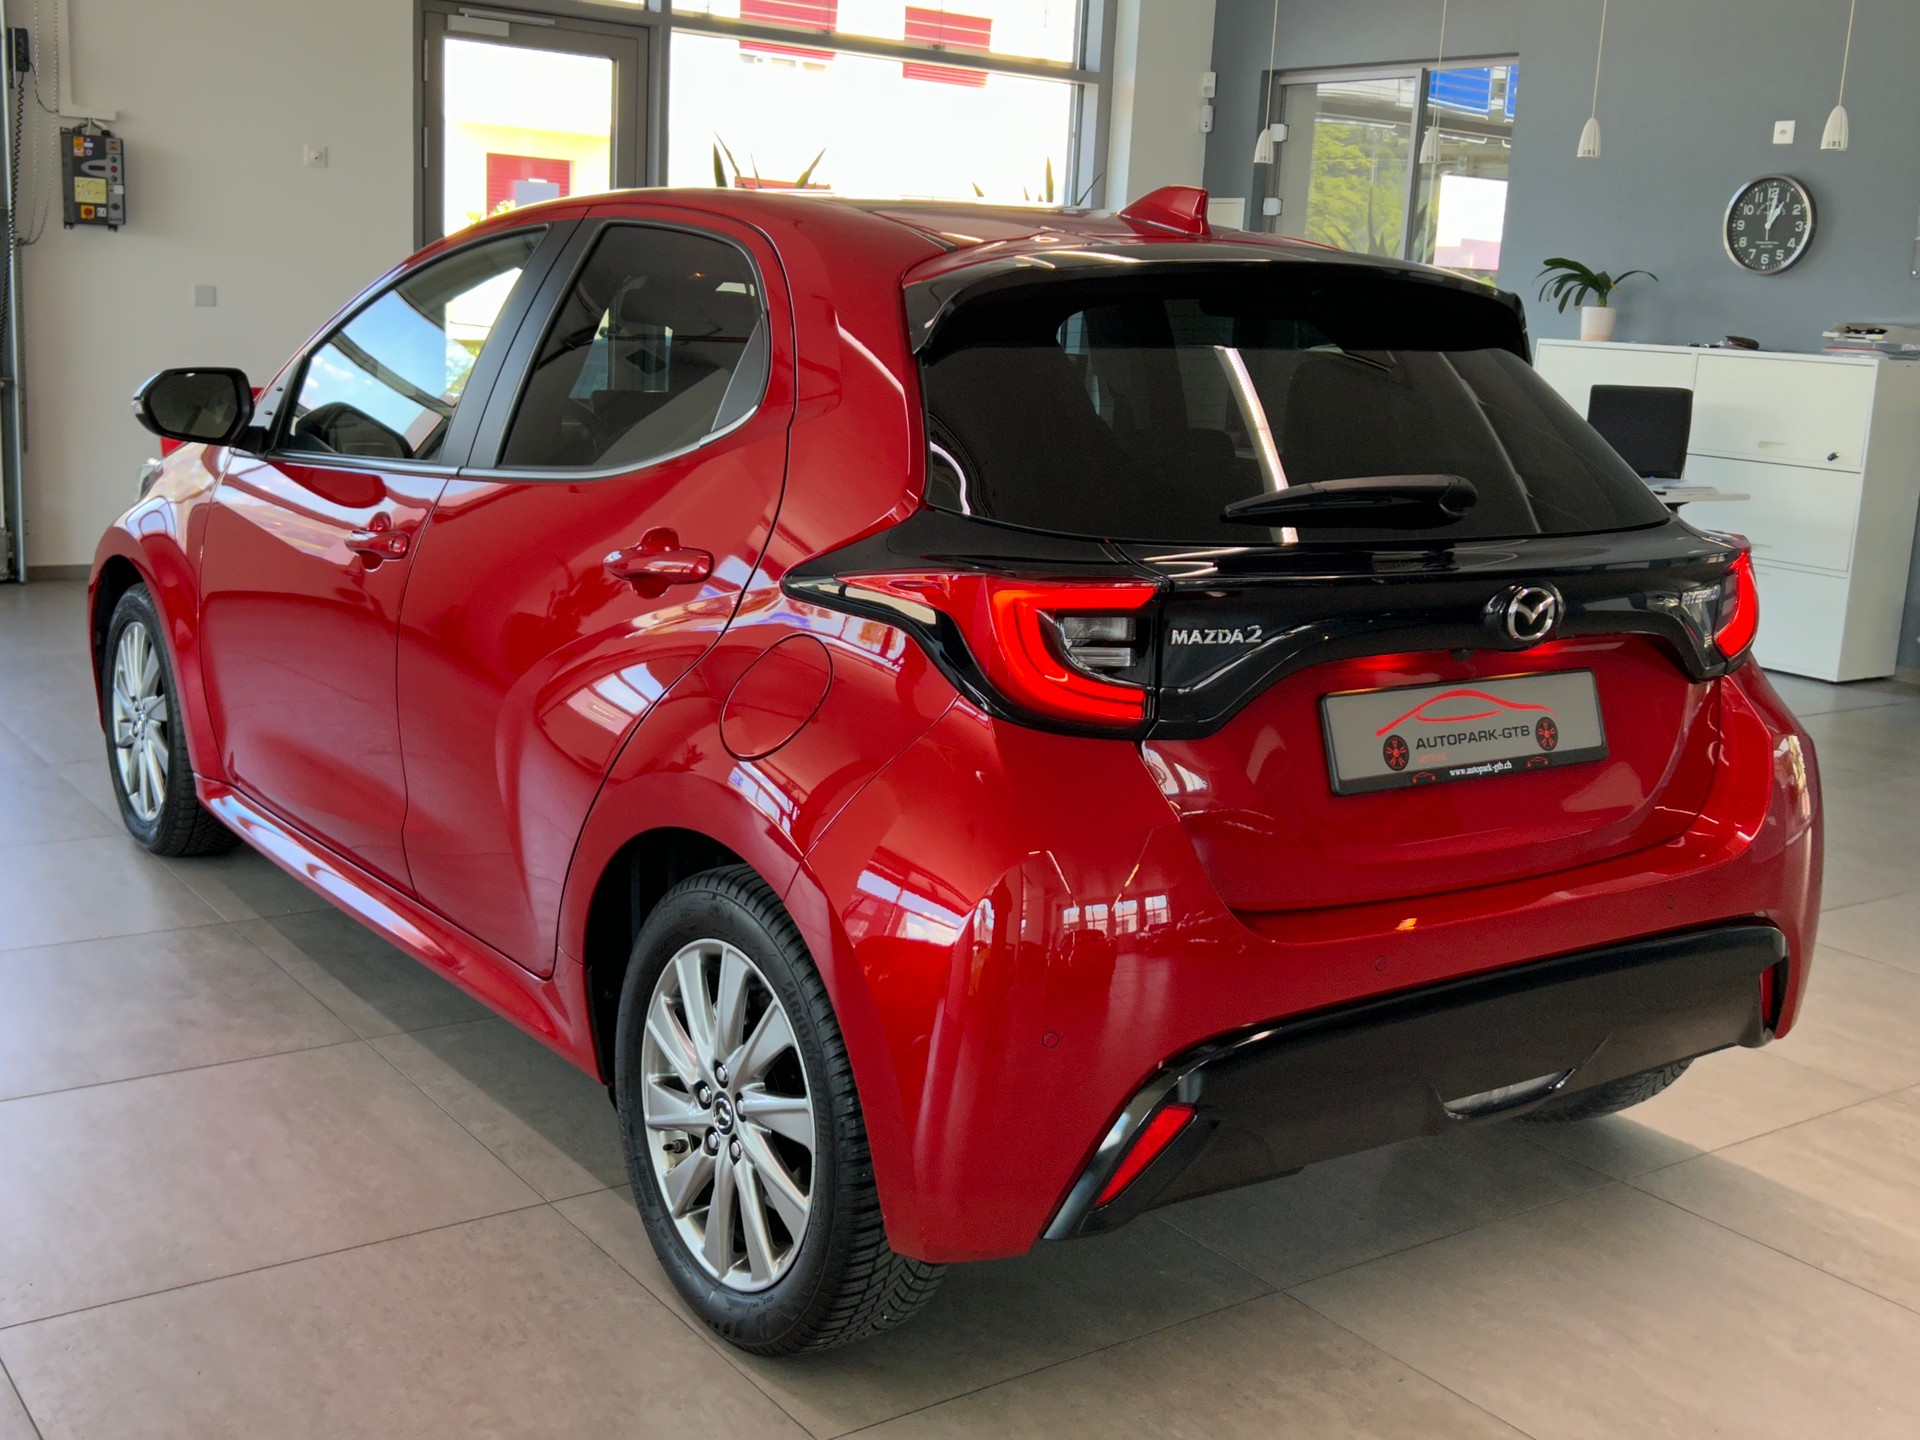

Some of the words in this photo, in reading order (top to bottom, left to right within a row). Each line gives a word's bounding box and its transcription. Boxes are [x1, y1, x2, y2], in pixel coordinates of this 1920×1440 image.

[1755, 192, 1764, 203] 11
[1768, 187, 1779, 198] 12
[1743, 205, 1754, 215] 10
[1792, 204, 1801, 215] 2
[1737, 220, 1745, 230] 9
[1795, 221, 1803, 231] 3
[1739, 237, 1747, 248] 8
[1787, 238, 1796, 248] 4
[1748, 249, 1757, 259] 7
[1761, 254, 1769, 264] 6
[1776, 250, 1784, 260] 5
[1170, 625, 1263, 645] MAZDA2
[1415, 724, 1531, 750] AUTOPARK-GTB
